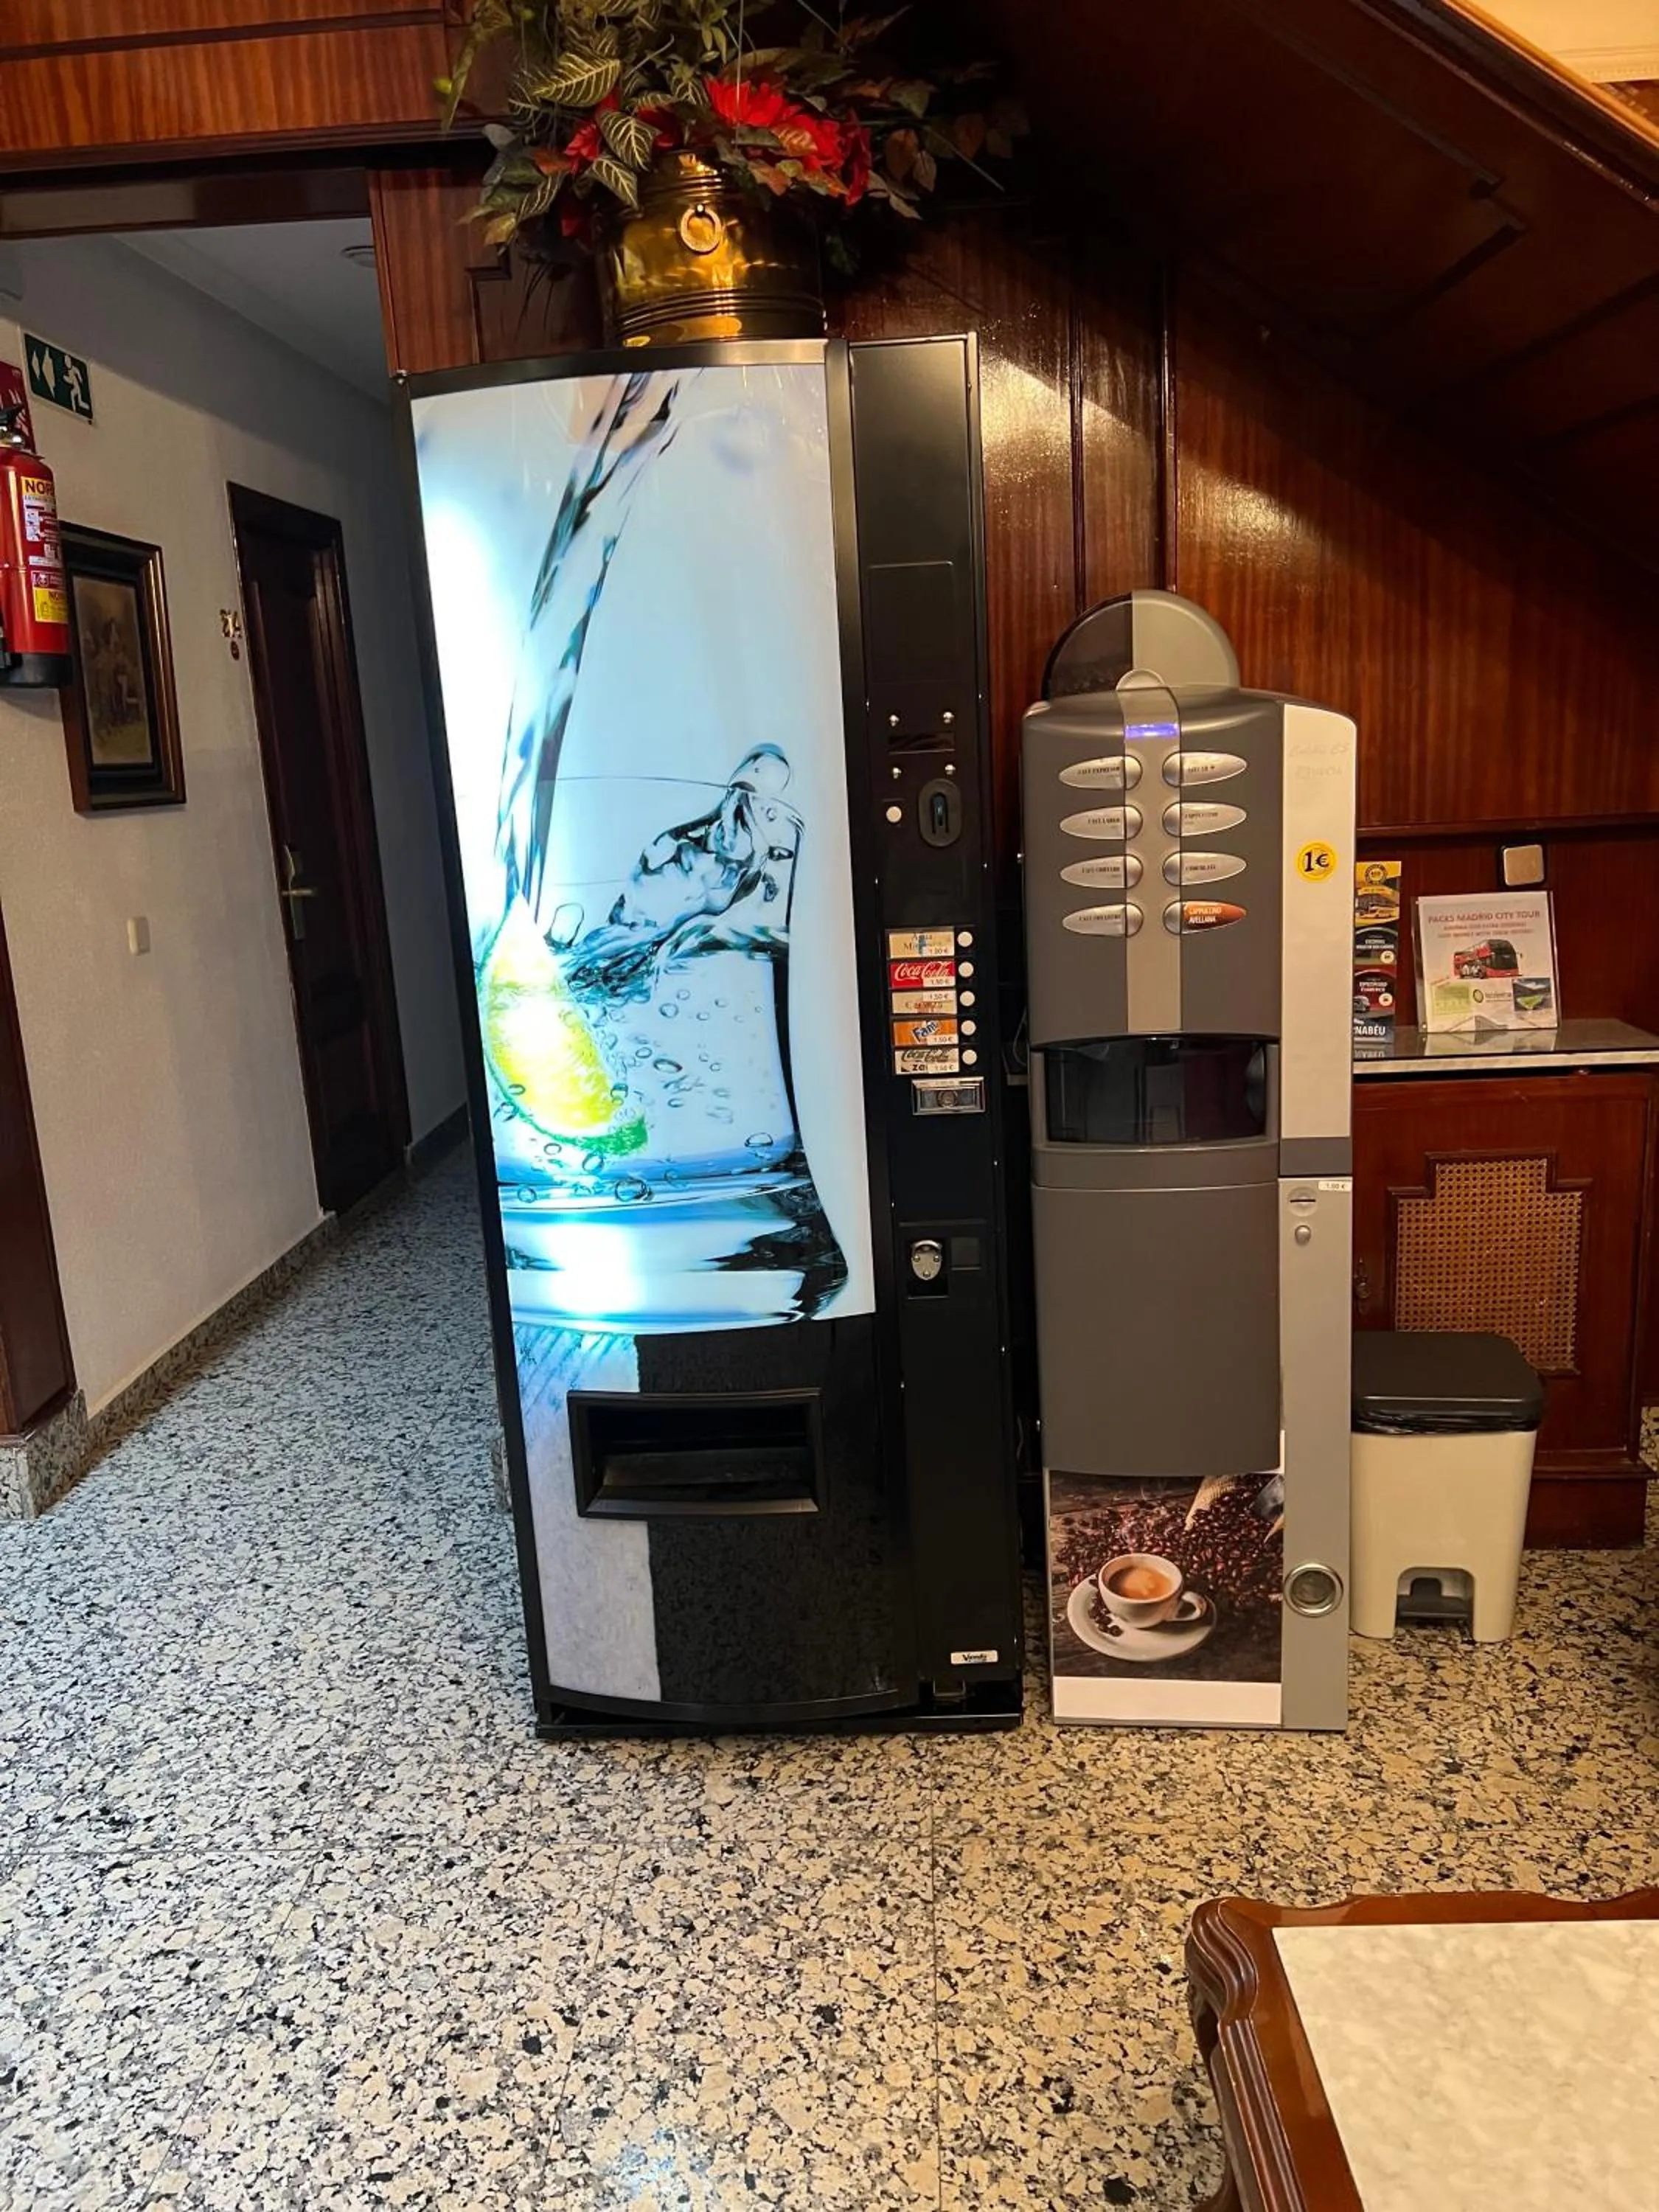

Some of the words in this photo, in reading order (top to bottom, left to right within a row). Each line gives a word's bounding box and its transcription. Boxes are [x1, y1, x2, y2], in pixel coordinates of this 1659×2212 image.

[1456, 913, 1493, 921] MADRID
[1495, 911, 1513, 919] CITY
[1516, 910, 1540, 918] TOUR
[1354, 1024, 1385, 1035] NABÉU
